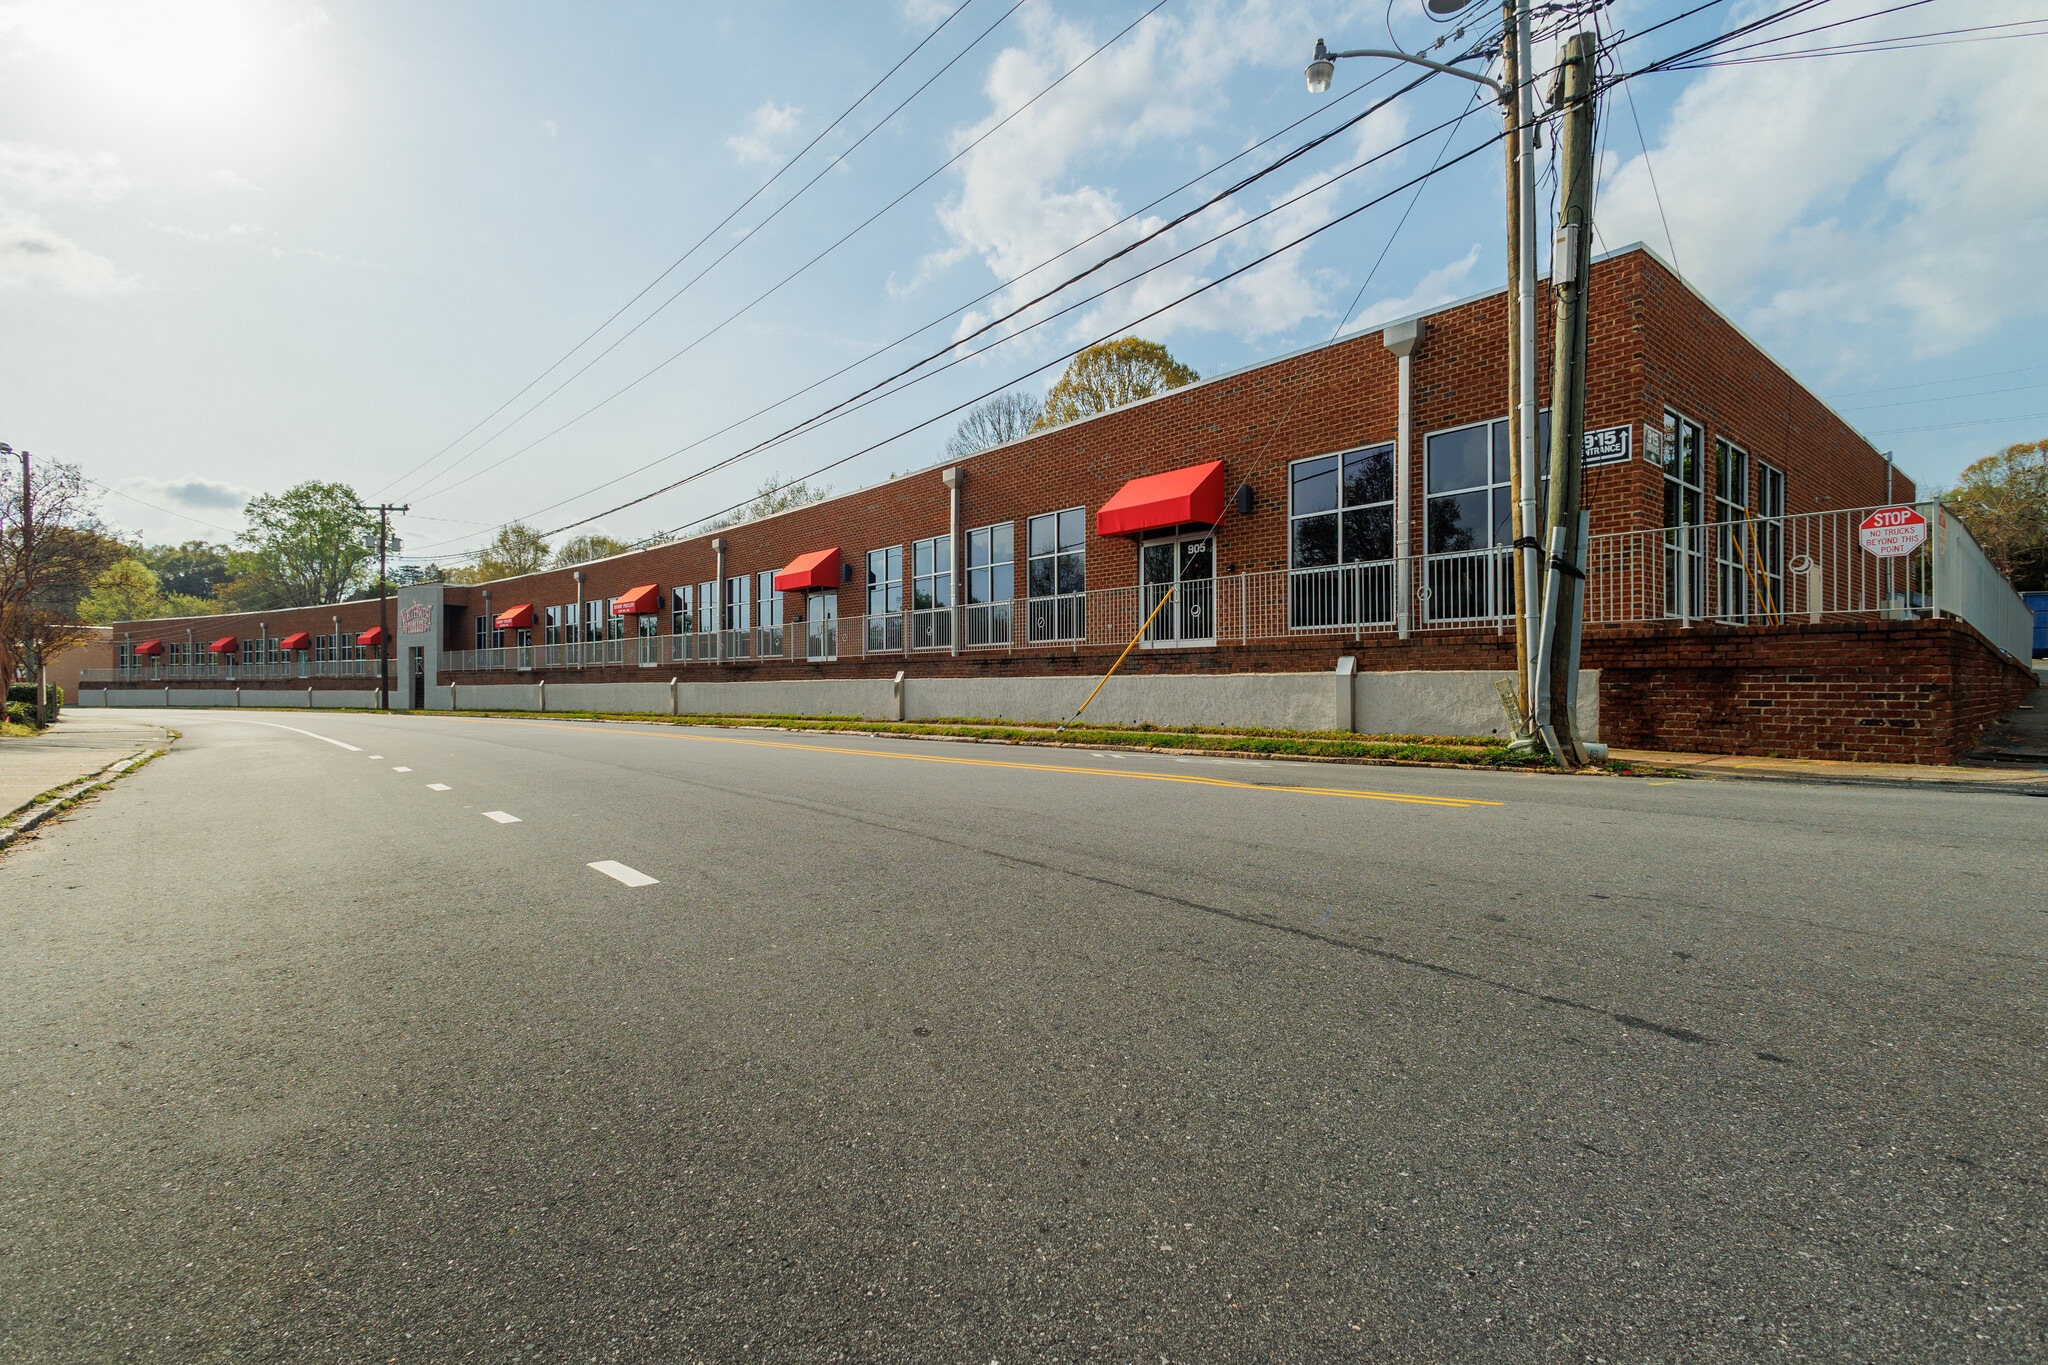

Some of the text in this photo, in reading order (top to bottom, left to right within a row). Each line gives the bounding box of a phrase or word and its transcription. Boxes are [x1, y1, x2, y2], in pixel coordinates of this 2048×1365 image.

[1873, 510, 1911, 527] STOP
[1870, 526, 1915, 538] NO TRUCKS
[1866, 534, 1920, 547] BEYOND THIS
[1187, 542, 1206, 555] 905
[1880, 544, 1905, 554] POINT
